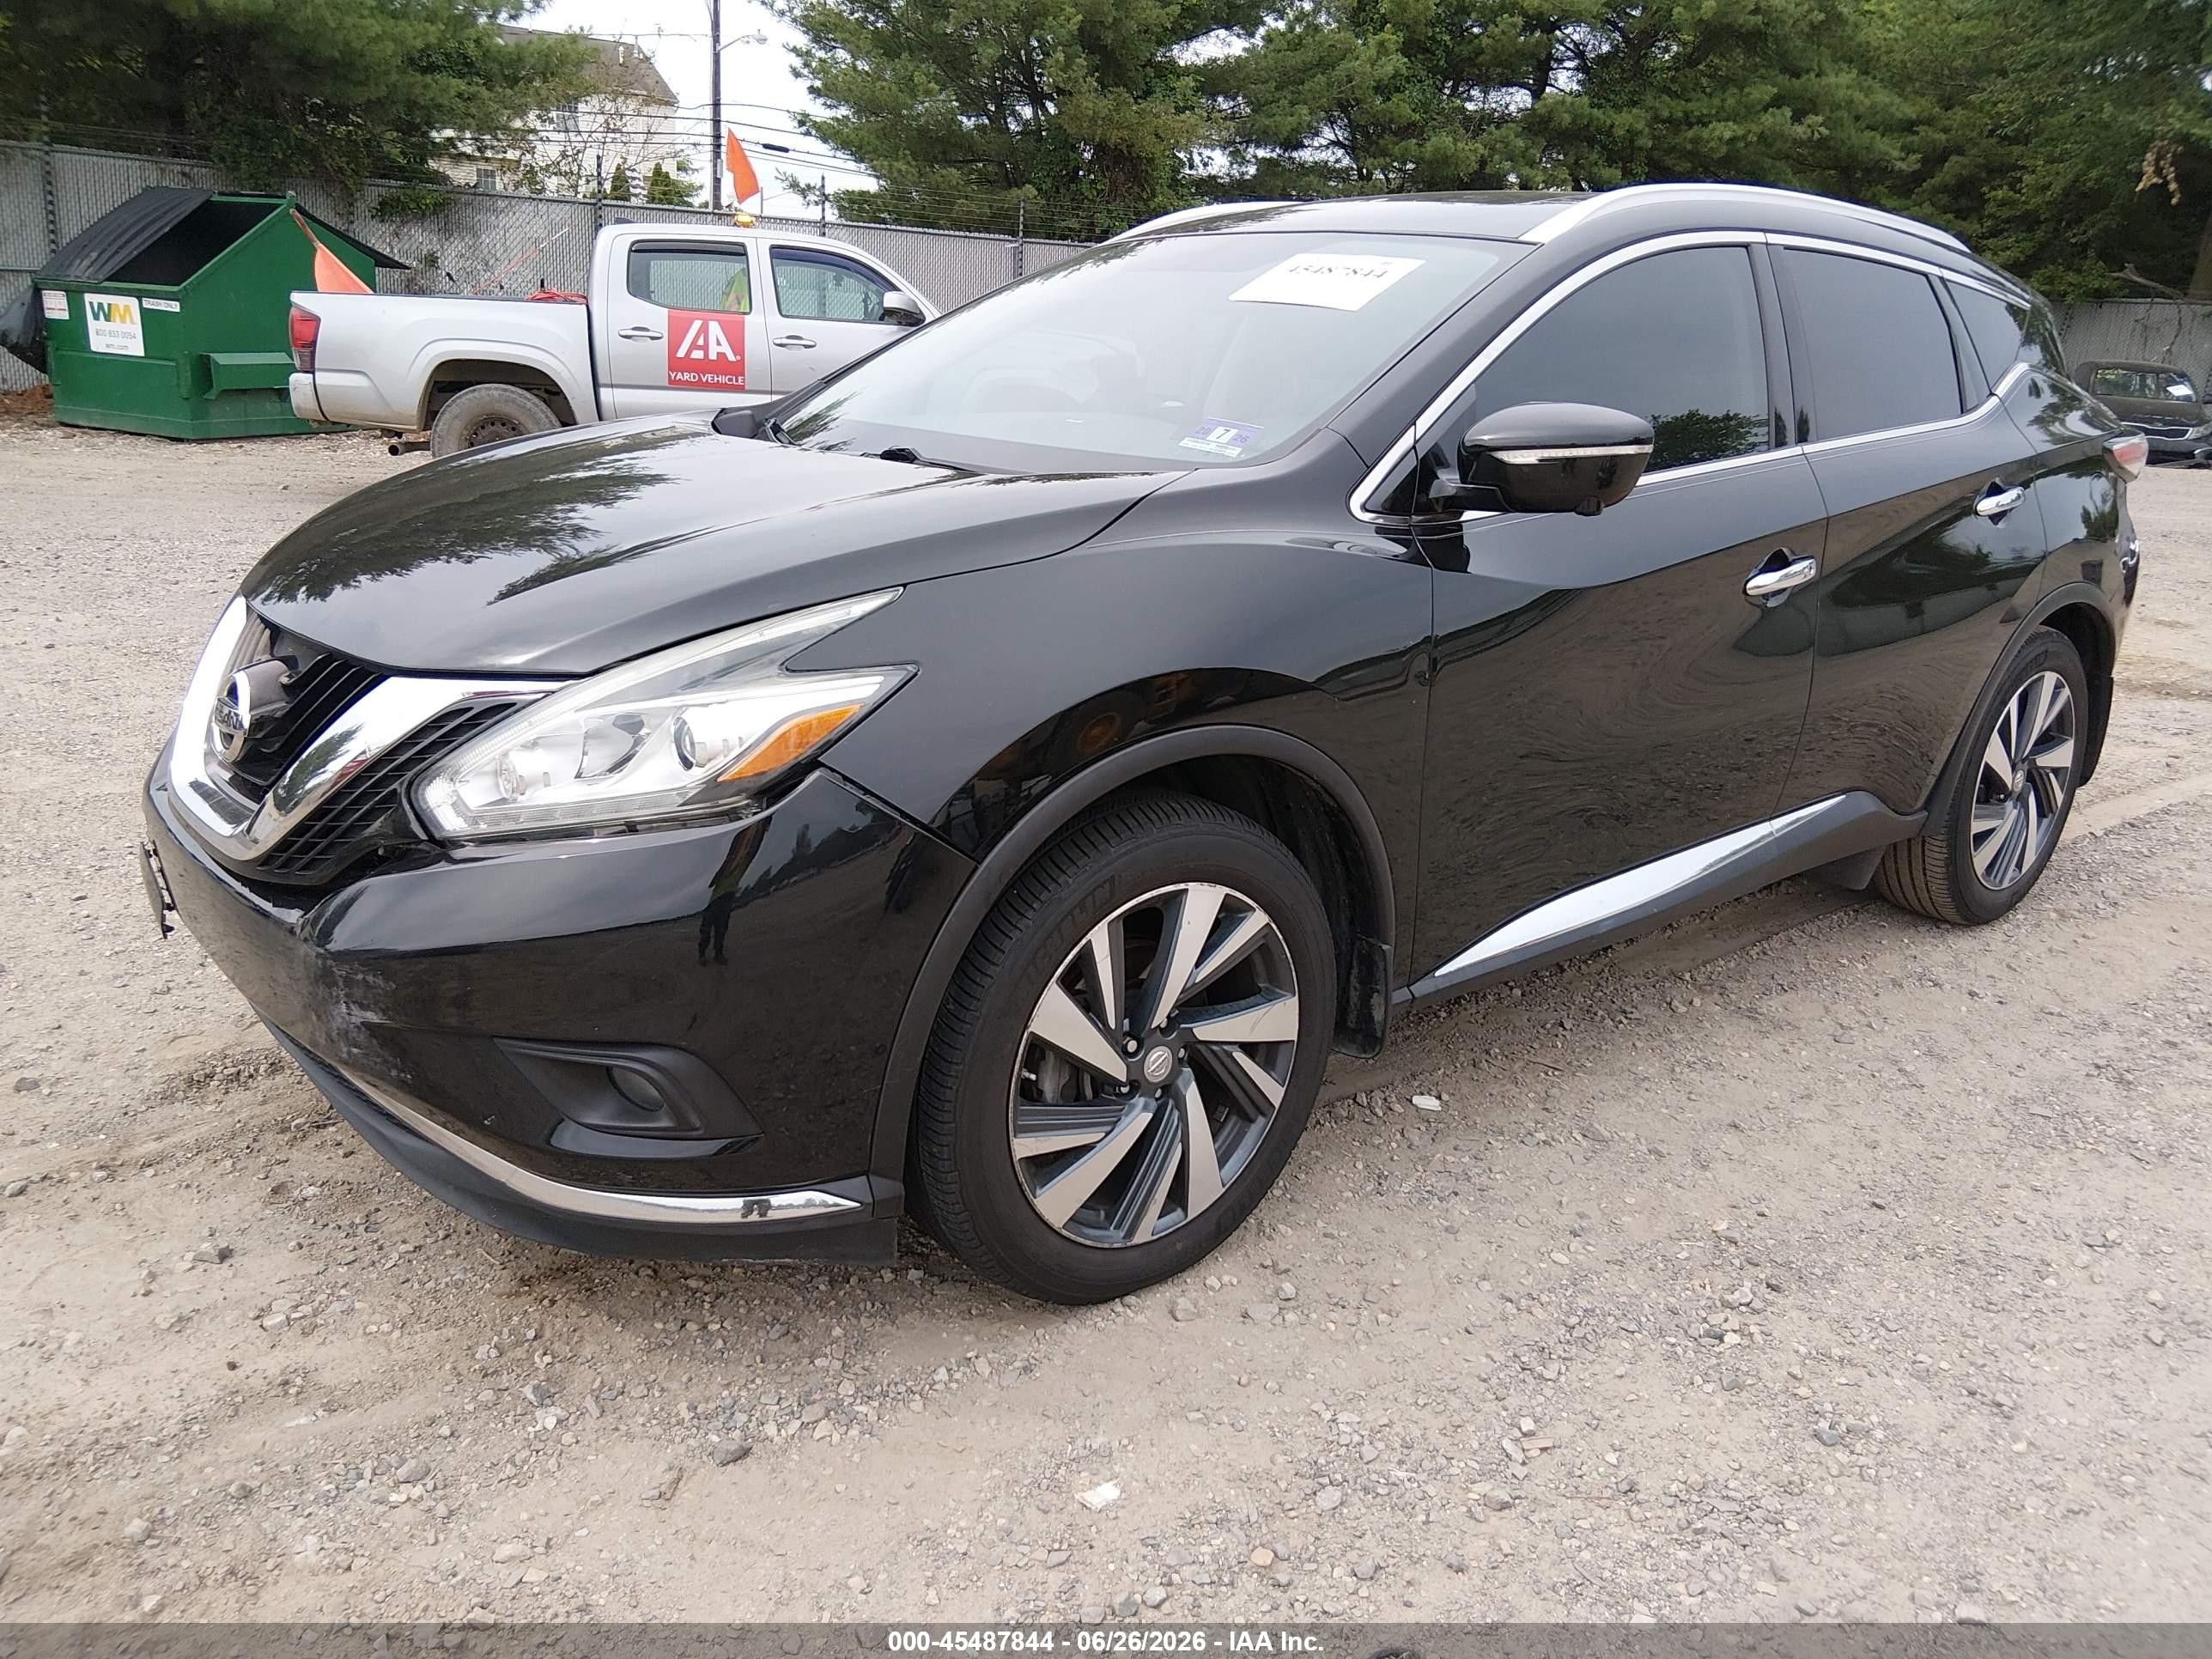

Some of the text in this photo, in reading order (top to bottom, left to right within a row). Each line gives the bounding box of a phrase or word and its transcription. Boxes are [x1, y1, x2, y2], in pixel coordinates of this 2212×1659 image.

[144, 299, 179, 310] TRASH ONLY
[89, 301, 137, 325] WM
[669, 370, 744, 385] YARD VEHICLE
[1195, 427, 1211, 435] 20
